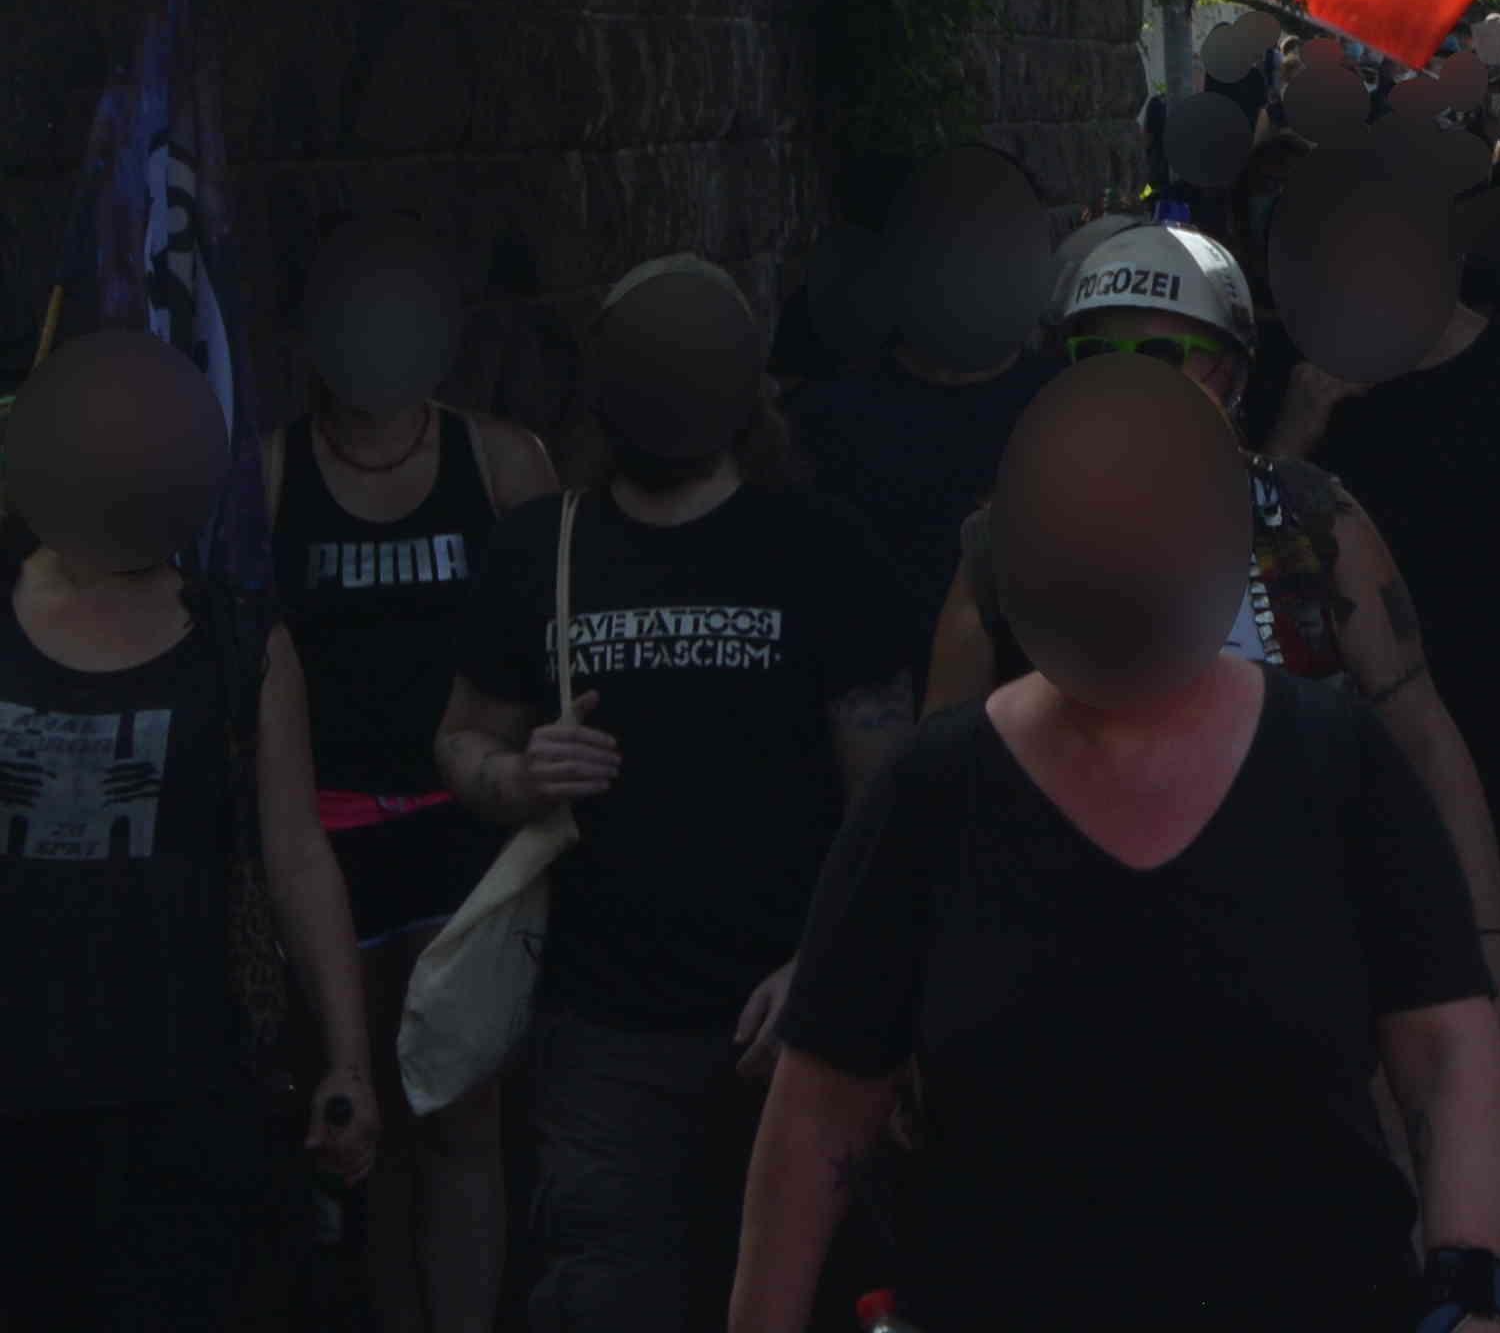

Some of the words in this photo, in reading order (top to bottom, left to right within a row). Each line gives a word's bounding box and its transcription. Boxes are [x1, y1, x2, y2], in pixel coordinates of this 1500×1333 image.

[306, 532, 468, 589] PUMA
[548, 614, 625, 647] OVE
[636, 609, 775, 636] TATTOOS
